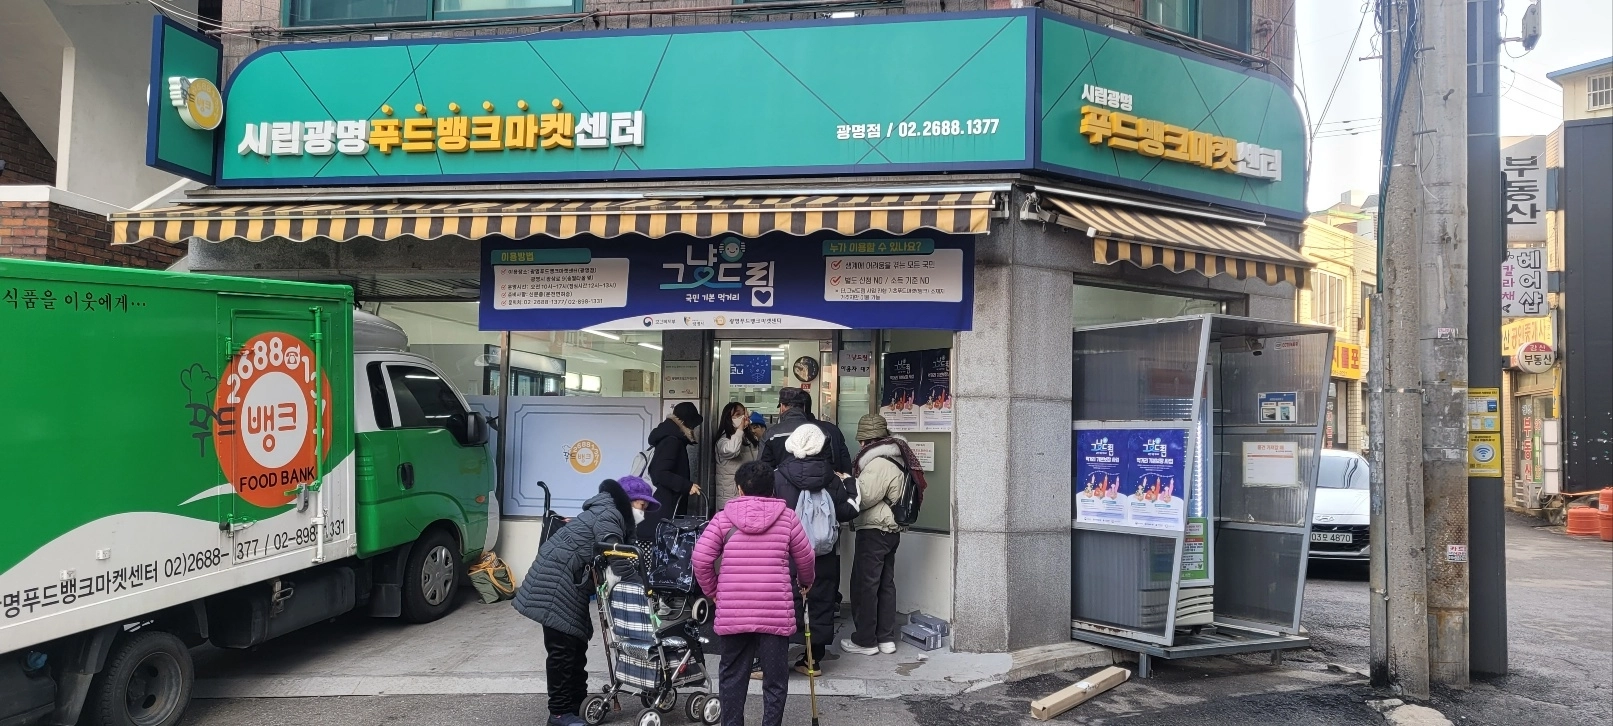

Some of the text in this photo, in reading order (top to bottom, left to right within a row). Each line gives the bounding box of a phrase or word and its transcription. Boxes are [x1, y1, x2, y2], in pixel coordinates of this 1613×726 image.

[1081, 83, 1133, 111] 시립광명
[836, 118, 1000, 140] 광명점 / 02.2688.1377
[1079, 105, 1283, 182] 푸드뱅크마켓센터
[1504, 155, 1540, 225] 부동산
[501, 252, 534, 262] 이용방법
[830, 242, 921, 252] 누가 이용할 수 있나요?
[866, 261, 891, 270] 어려움을
[907, 260, 920, 269] 모든
[923, 260, 935, 269] 국민
[859, 276, 872, 285] 신청
[891, 276, 904, 284] 소득
[905, 276, 918, 285] 기준
[1516, 250, 1544, 314] 헤어샵
[2, 287, 58, 310] 식품을
[685, 293, 740, 303] 국민 기본 먹거리
[1524, 354, 1552, 366] 부동산
[247, 402, 297, 453] 뱅크
[239, 466, 315, 493] FOOD BANK
[1330, 533, 1351, 543] 4870
[0, 561, 158, 619] 명푸드뱅크마켓센터
[164, 539, 259, 578] 02)2688-377
[264, 534, 270, 555] /
